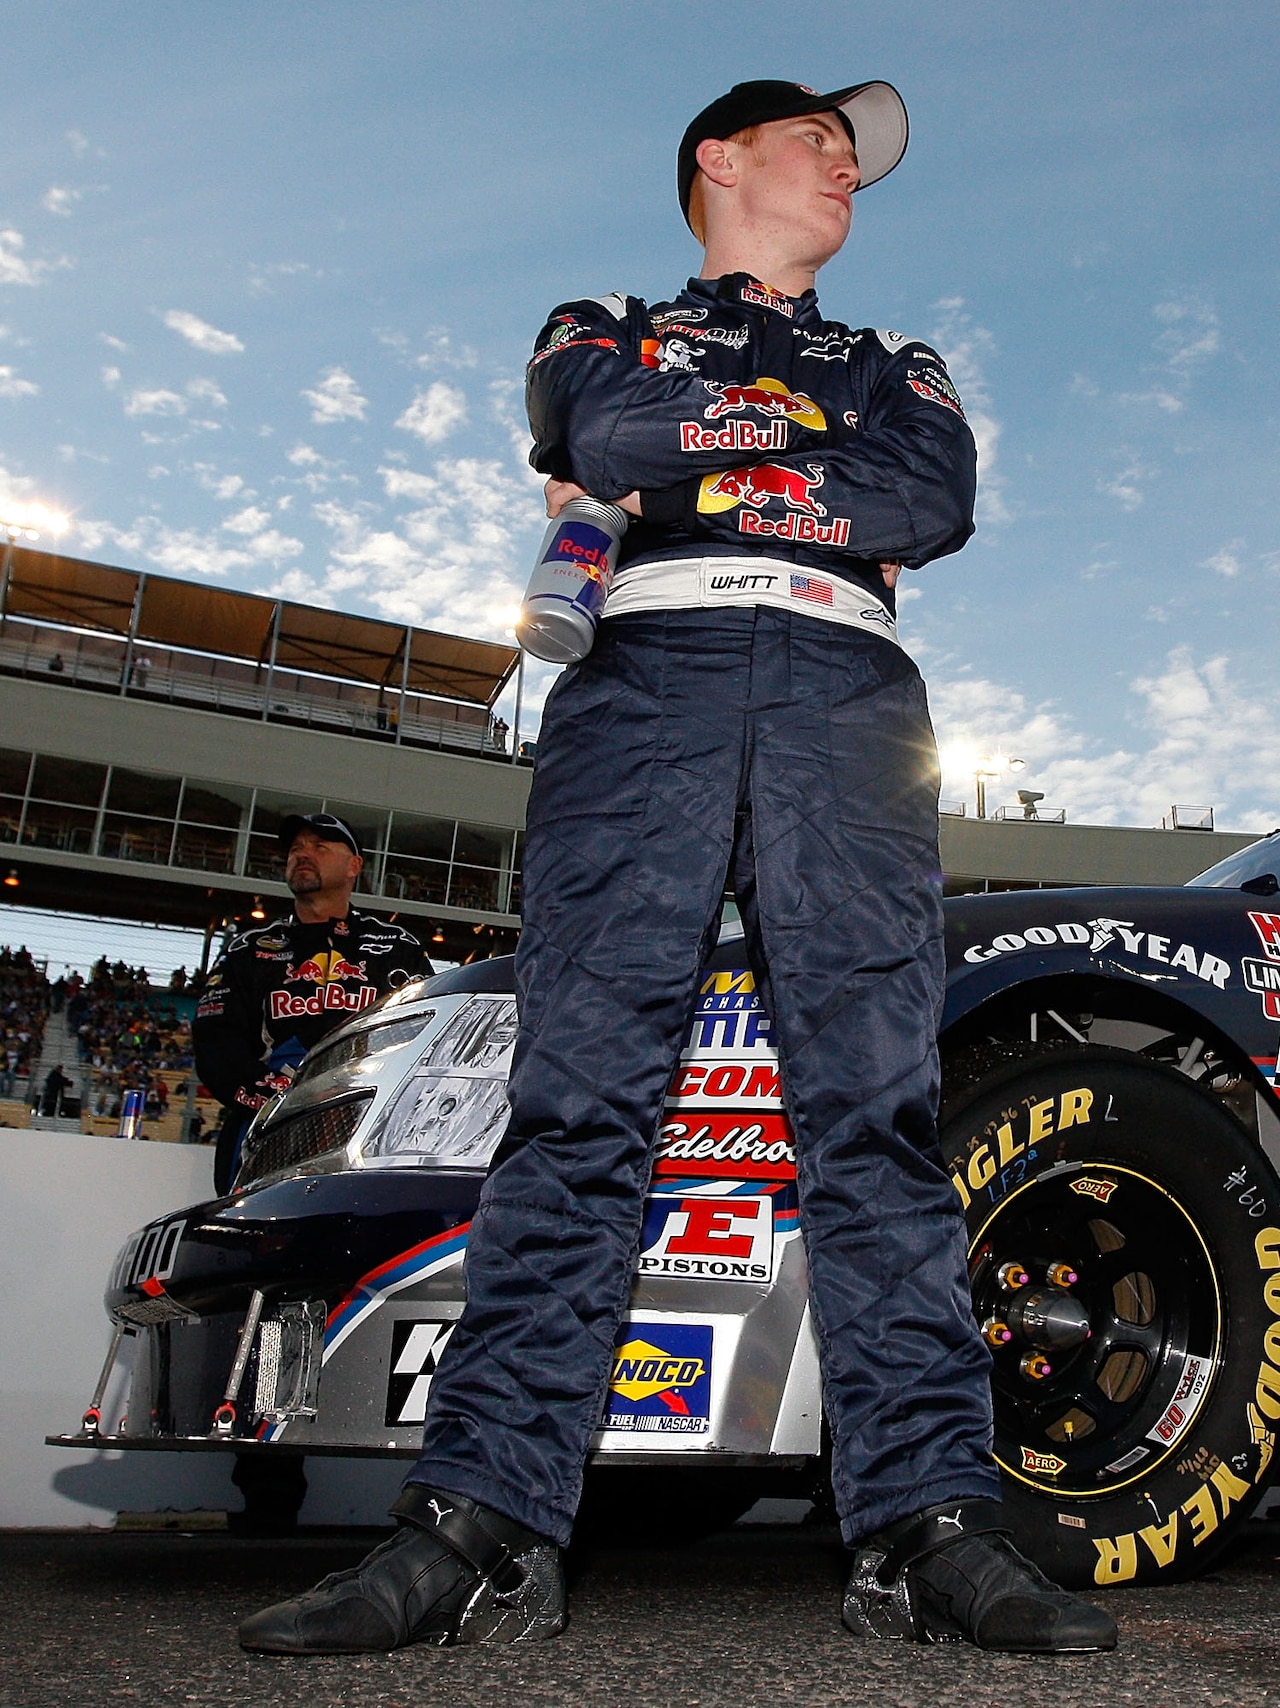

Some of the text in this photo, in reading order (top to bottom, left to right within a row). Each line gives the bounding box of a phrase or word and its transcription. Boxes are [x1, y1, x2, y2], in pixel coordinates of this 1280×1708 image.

[741, 288, 794, 318] Red Bull
[680, 420, 787, 451] Red Bull
[738, 510, 851, 547] Red Bull
[557, 539, 600, 562] Red
[553, 568, 588, 584] ENERG
[710, 574, 778, 591] WHITT
[271, 983, 378, 1020] Red Bull
[1077, 1180, 1110, 1195] AERO
[640, 1257, 767, 1278] PISTONS
[1192, 1373, 1206, 1396] 092
[609, 1413, 702, 1431] FUEL NASCAR
[1155, 1402, 1187, 1442] 60
[1026, 1455, 1058, 1470] AERO
